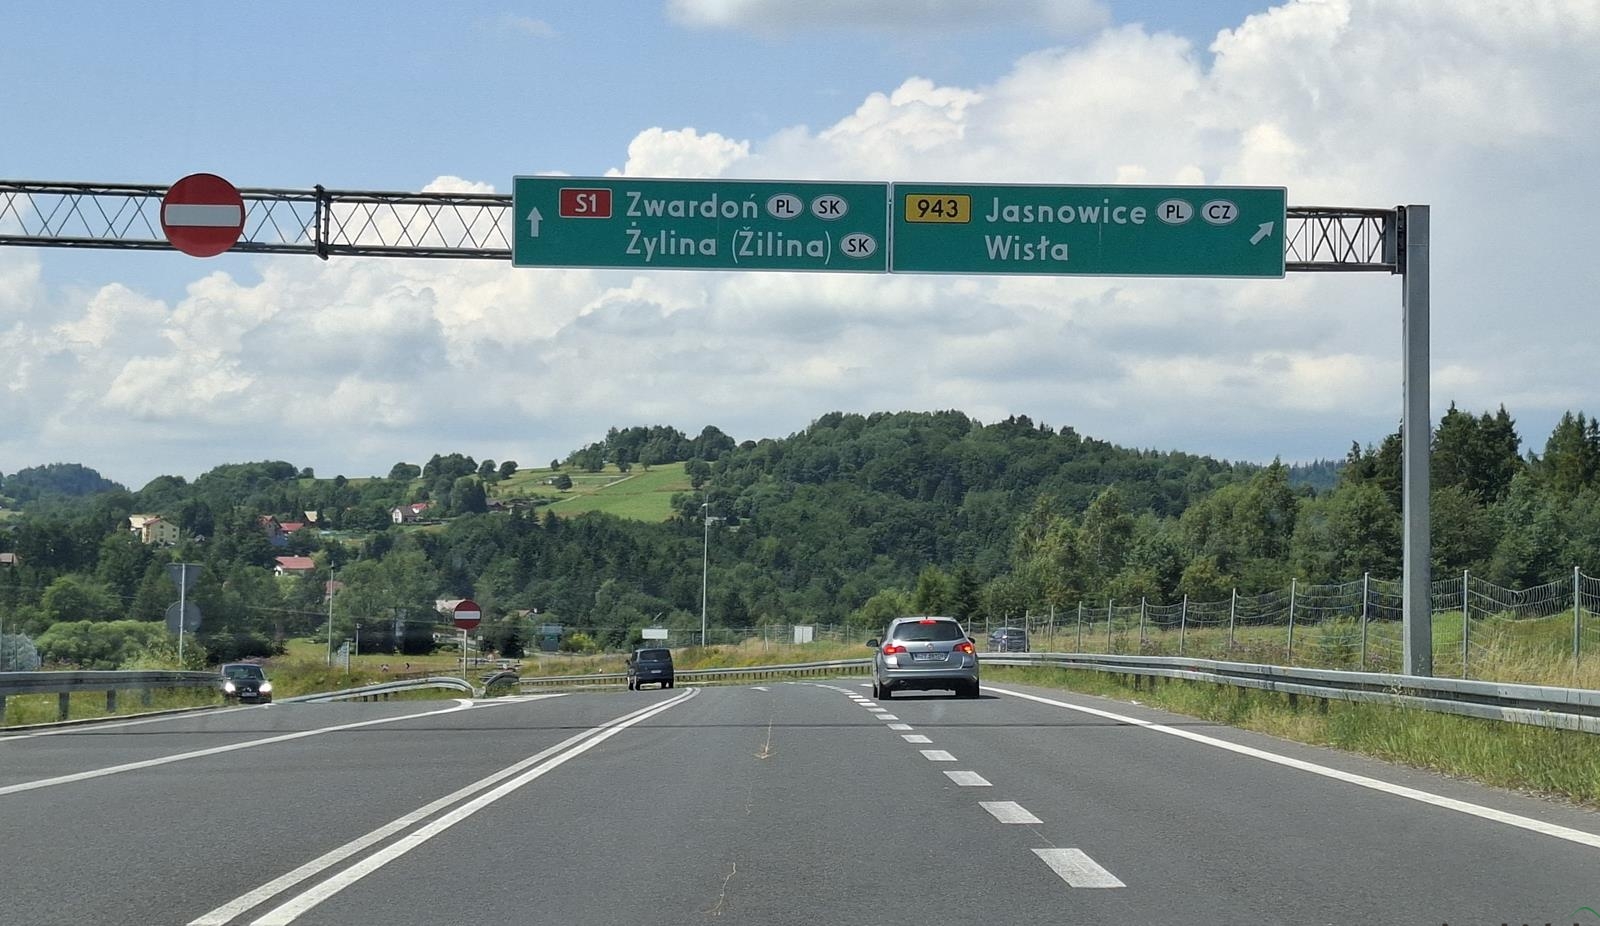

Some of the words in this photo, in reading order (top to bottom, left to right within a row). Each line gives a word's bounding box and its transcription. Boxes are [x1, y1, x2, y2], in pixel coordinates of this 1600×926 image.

[575, 194, 596, 212] S1
[626, 191, 758, 219] Zwardoń
[775, 201, 795, 215] PL
[818, 200, 840, 215] SK
[917, 200, 958, 218] 943
[986, 197, 1146, 225] Jasnowice
[1166, 205, 1185, 219] PL
[1208, 205, 1231, 220] CZ
[626, 222, 717, 262] Żylina
[732, 226, 832, 264] (Žilina)
[847, 238, 870, 253] SK
[985, 234, 1069, 261] Wisła
